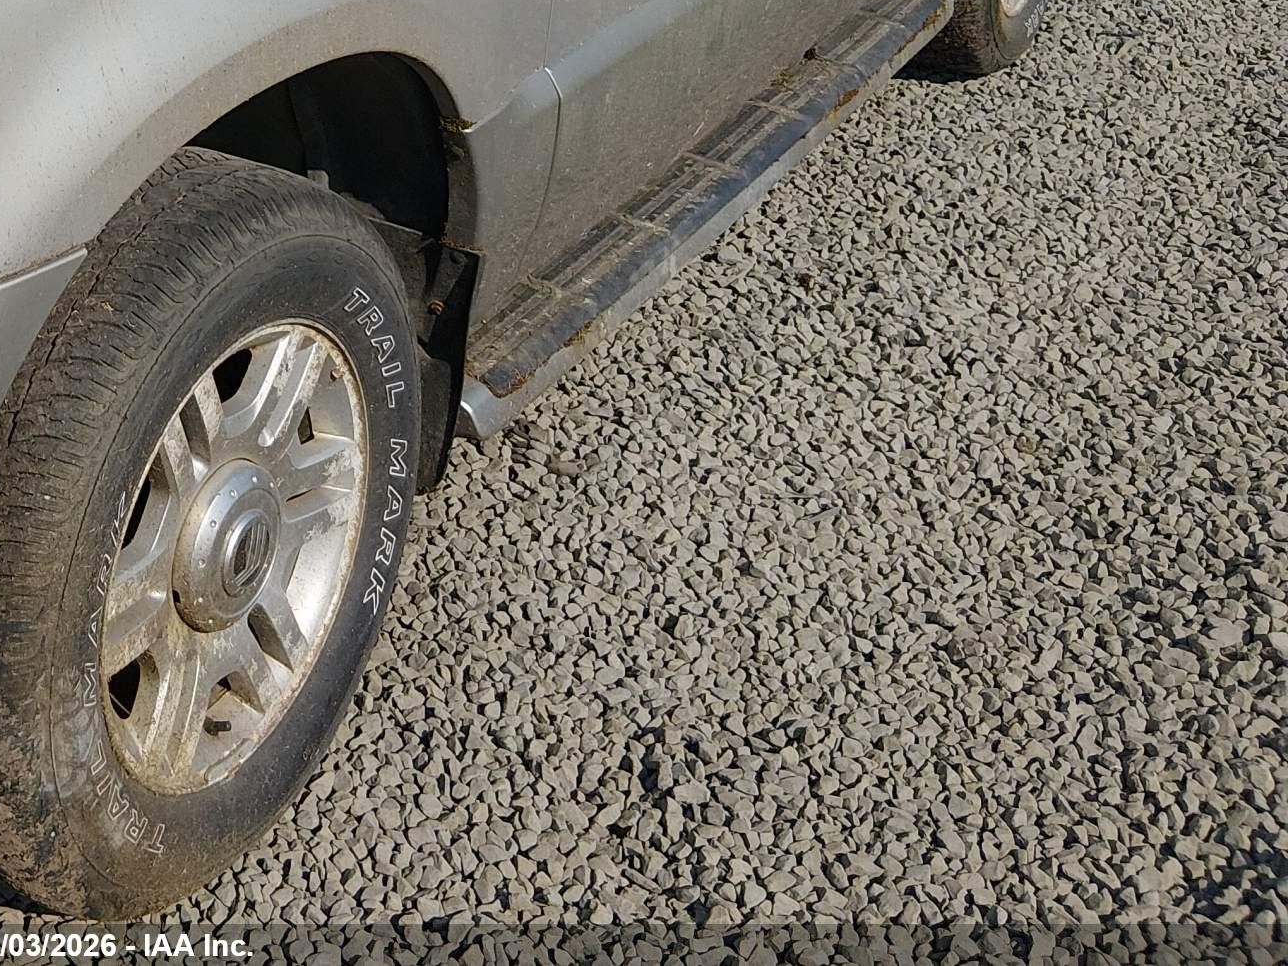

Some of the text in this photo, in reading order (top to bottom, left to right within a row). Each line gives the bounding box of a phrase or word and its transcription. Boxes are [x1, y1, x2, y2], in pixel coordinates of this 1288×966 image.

[344, 287, 408, 616] TRAIL MARK
[90, 737, 166, 854] TRAIL
